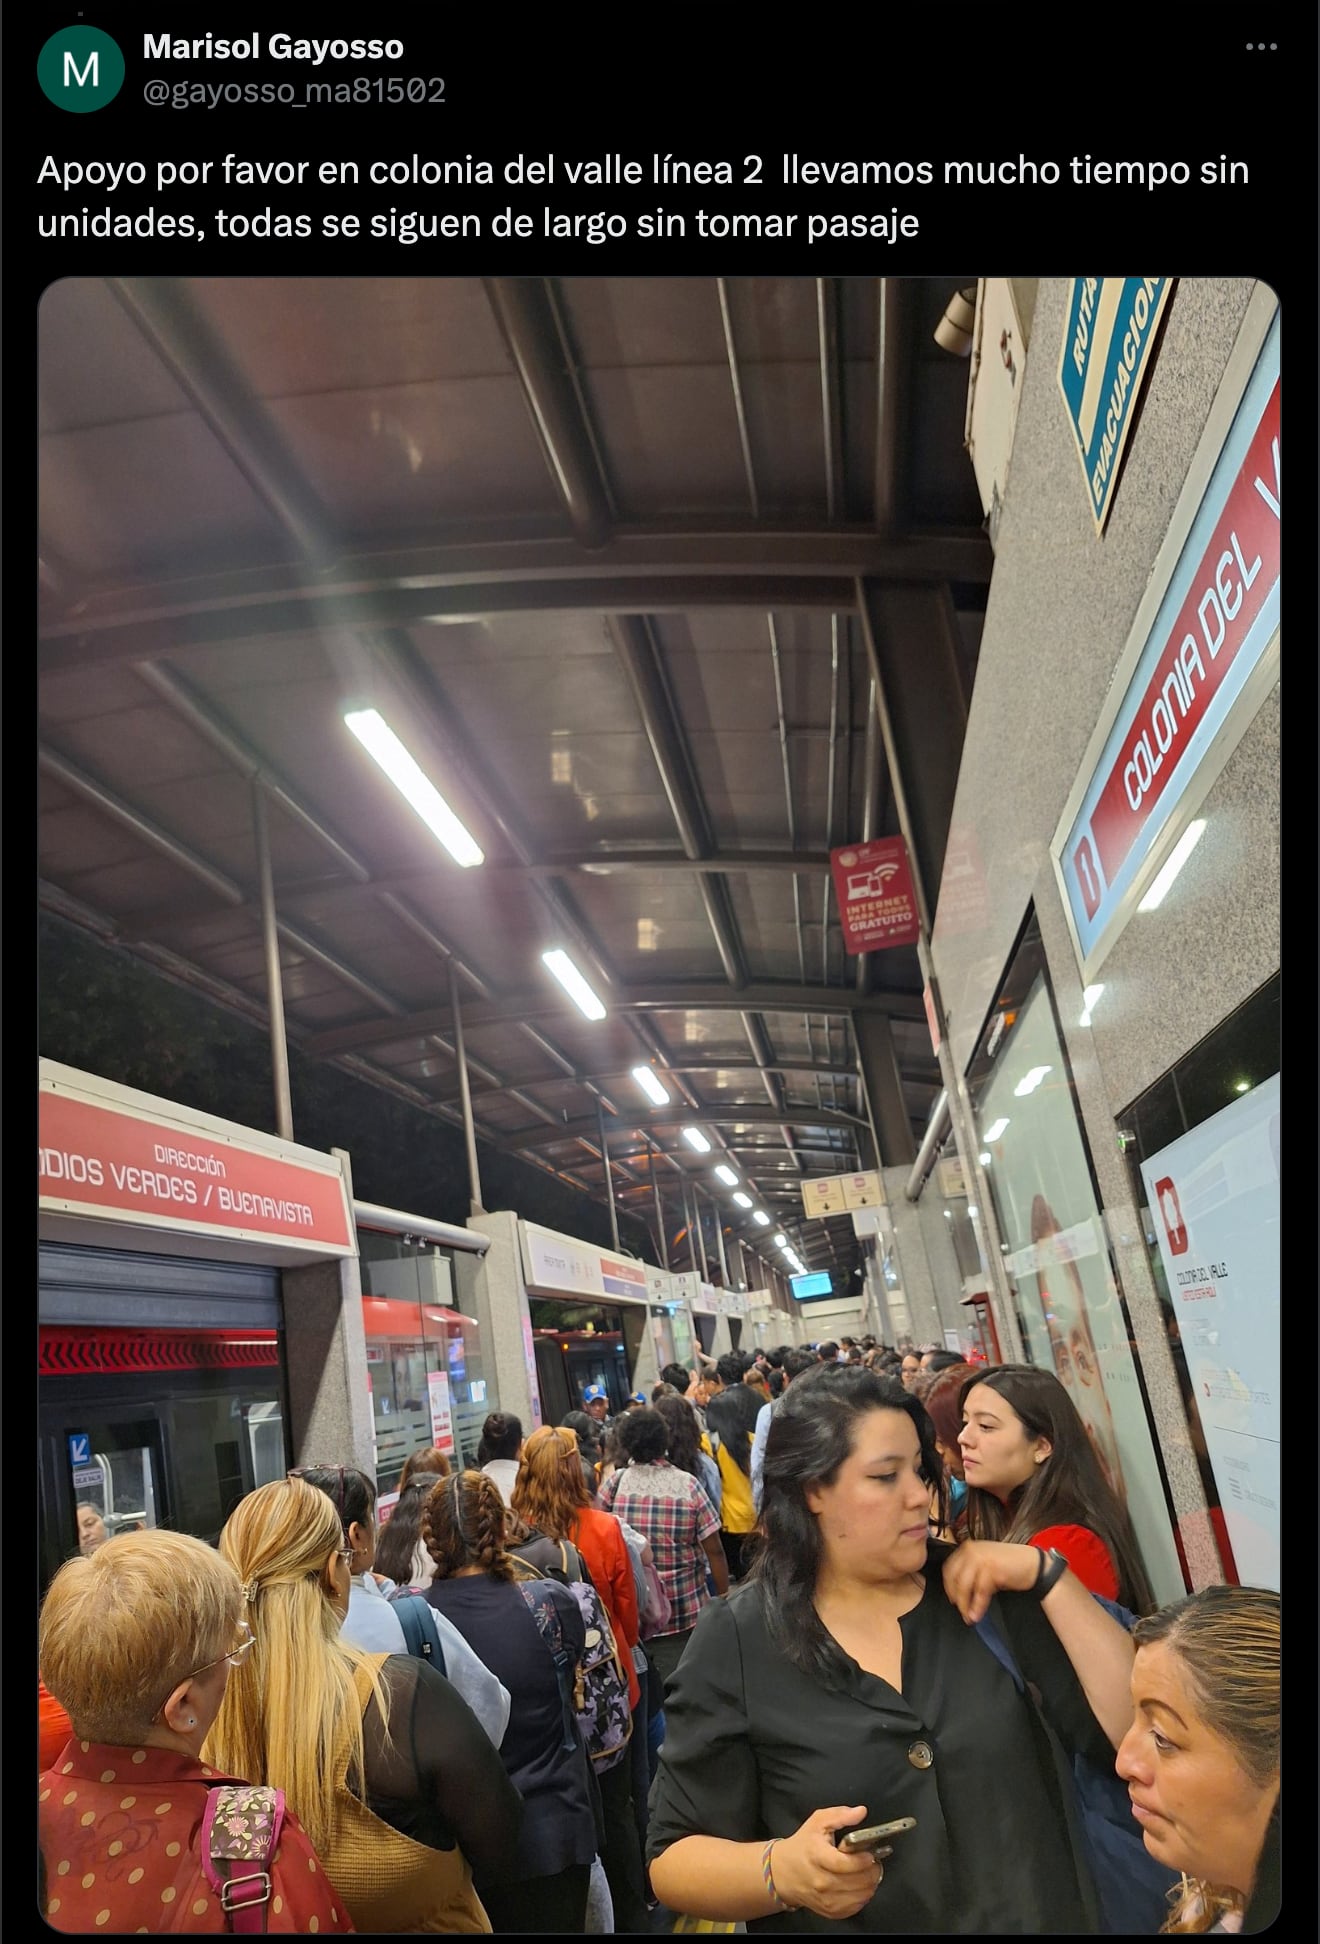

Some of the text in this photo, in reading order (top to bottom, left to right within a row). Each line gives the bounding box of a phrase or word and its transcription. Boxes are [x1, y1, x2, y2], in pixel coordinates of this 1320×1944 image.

[1073, 278, 1098, 377] RUTA
[1123, 633, 1206, 811] COLONIA
[1198, 531, 1262, 659] DEL
[846, 895, 908, 915] INTERNET
[848, 911, 875, 923] PARA
[849, 912, 913, 932] GRATUITO
[154, 1144, 226, 1179] DIRECCIÓN
[109, 1162, 197, 1206] VERDES
[203, 1184, 213, 1207] /
[218, 1187, 314, 1226] BUENAVISTA
